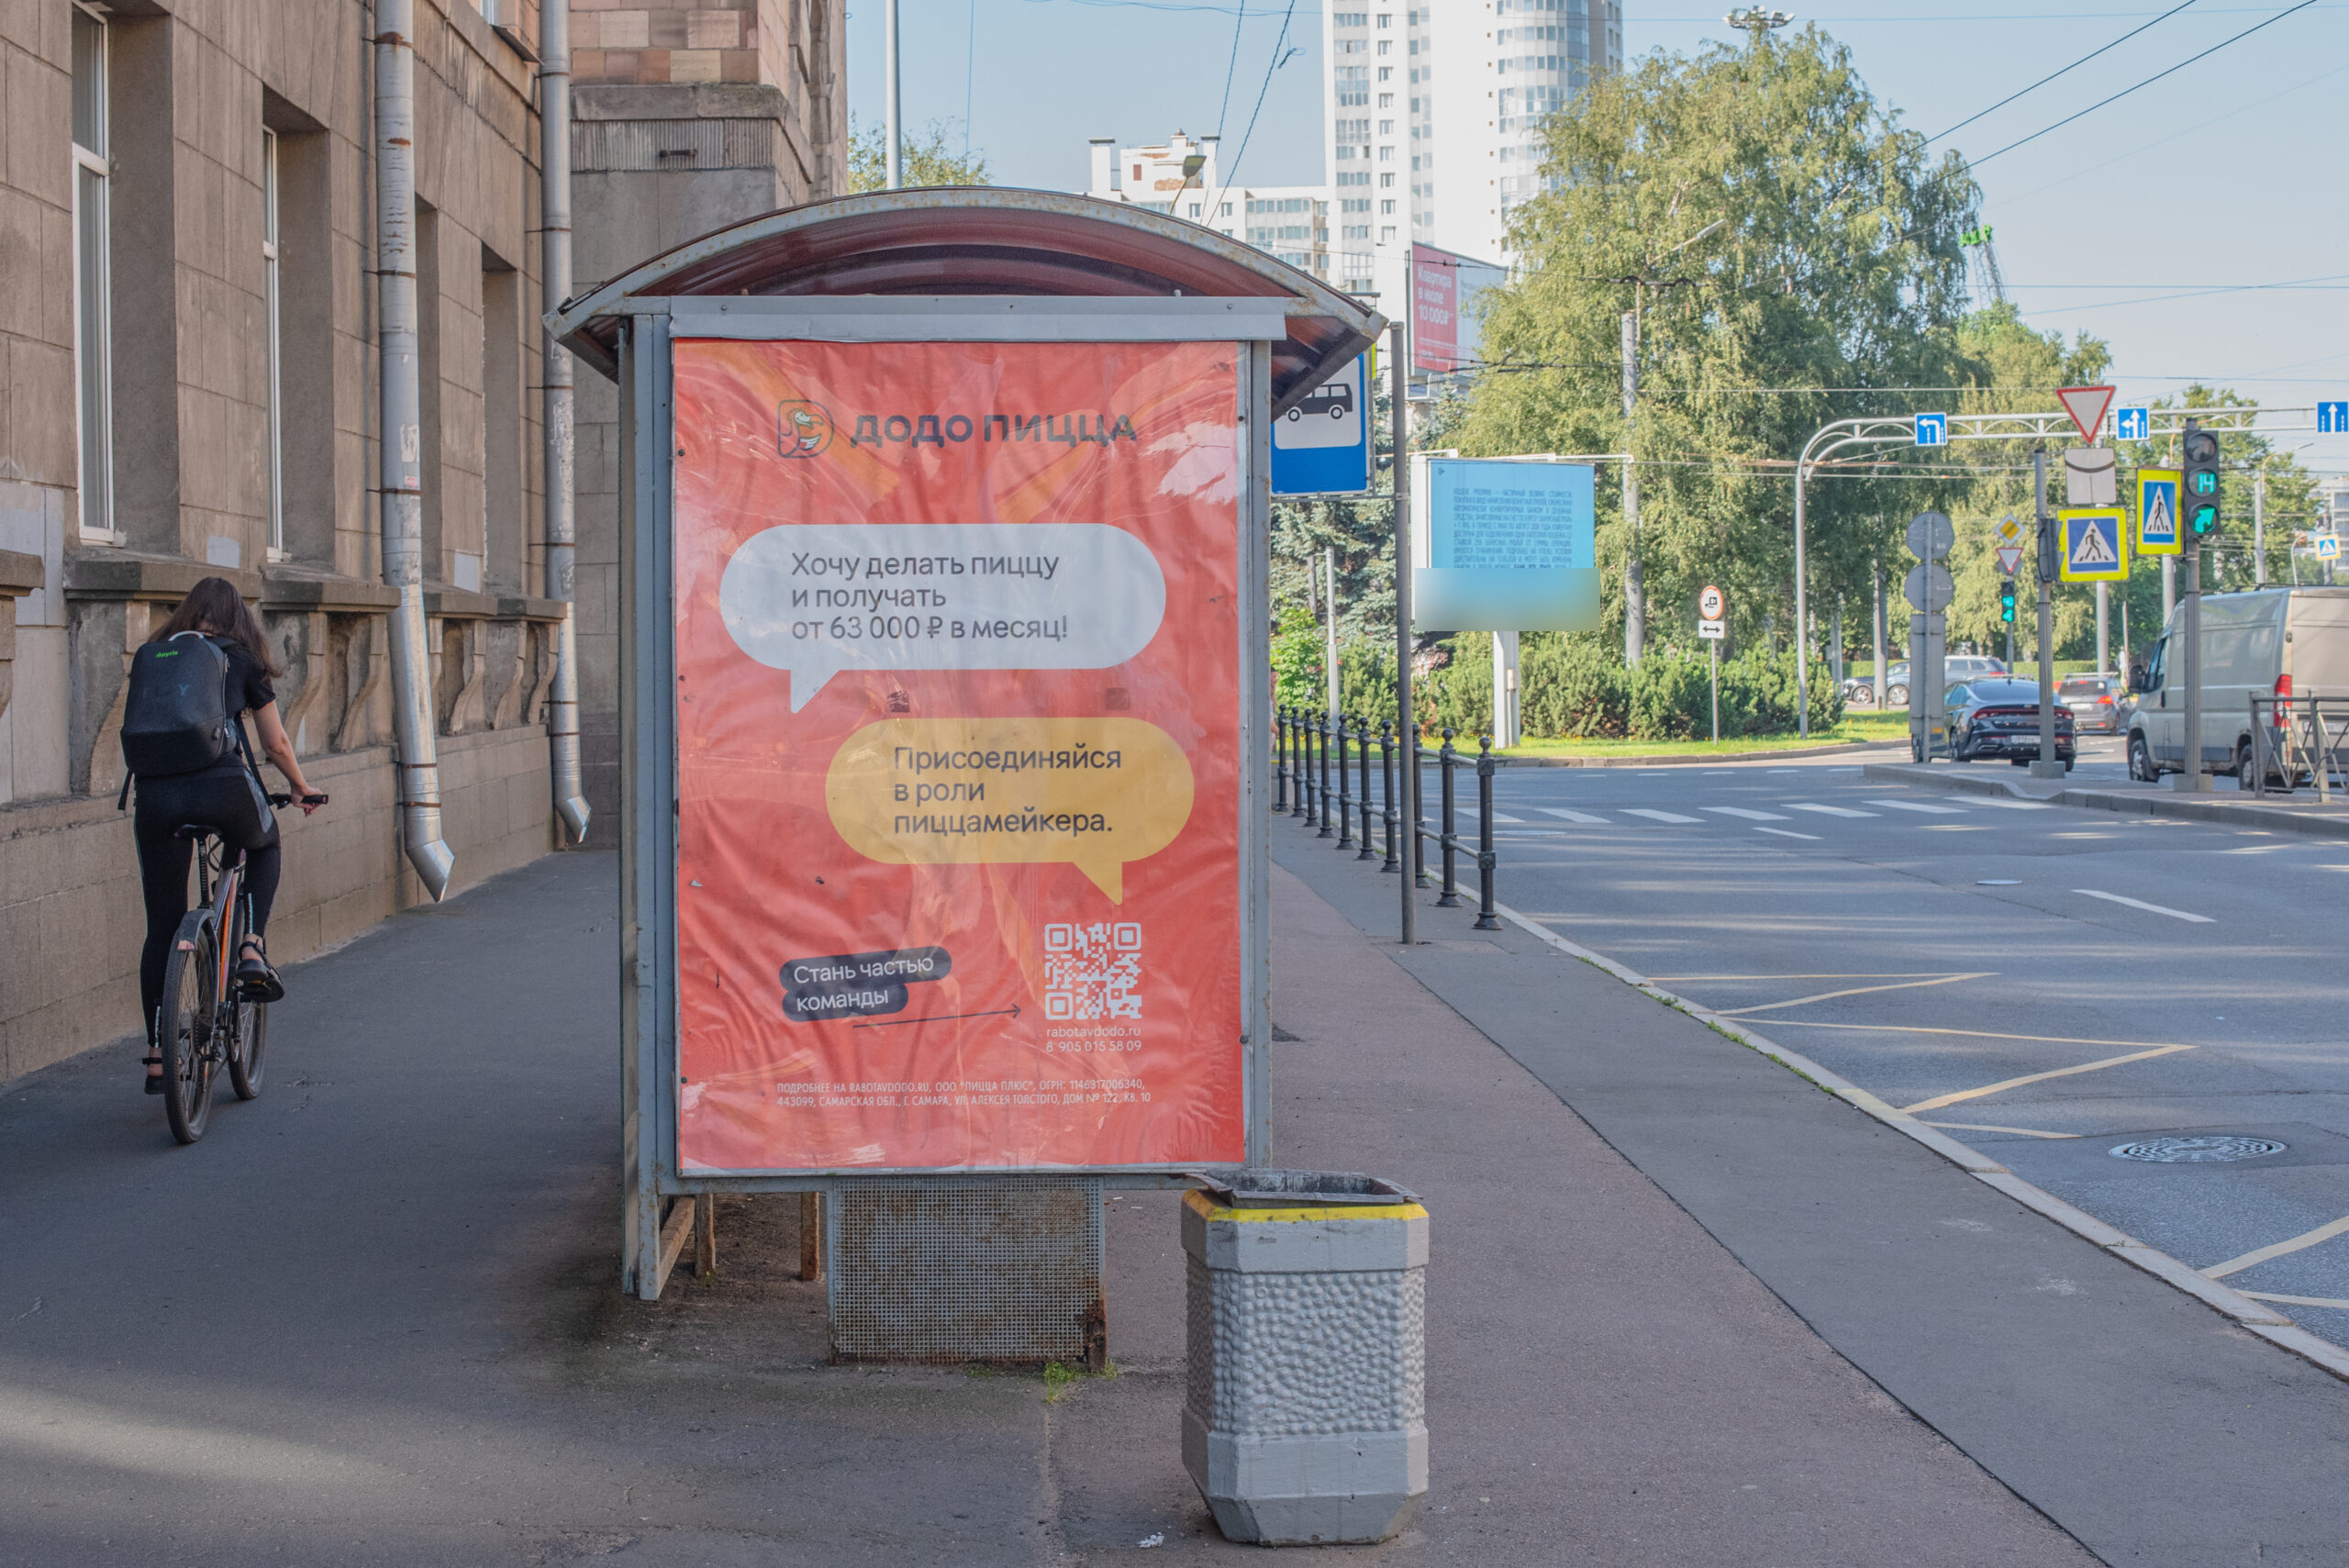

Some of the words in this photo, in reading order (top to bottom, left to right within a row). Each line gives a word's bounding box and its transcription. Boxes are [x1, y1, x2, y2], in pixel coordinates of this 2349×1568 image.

[850, 415, 974, 449] ДОДО
[984, 413, 1137, 449] ПИЦЦА
[2198, 473, 2215, 493] 14
[791, 552, 859, 581] Хочу
[866, 556, 965, 579] делать
[971, 555, 1060, 581] пиццу
[792, 589, 809, 607] и
[817, 588, 947, 612] получать
[791, 622, 824, 639] от
[829, 616, 863, 639] 63
[869, 616, 919, 639] 000
[927, 615, 944, 639] ₽
[952, 620, 965, 639] в
[971, 614, 1069, 642] месяц!
[894, 742, 1122, 774] Присоединяйся
[895, 784, 909, 802] в
[916, 782, 985, 808] роли
[894, 806, 1114, 838] пиццамейкера.
[793, 962, 857, 985] Стань
[860, 954, 935, 978] частью
[796, 988, 890, 1013] команды
[1046, 1025, 1141, 1038] rabotavdodo.ru
[1046, 1041, 1053, 1052] 8
[1059, 1041, 1082, 1052] 905
[1085, 1040, 1107, 1052] 015
[1108, 1040, 1124, 1051] 58
[1126, 1040, 1142, 1051] 09
[777, 1083, 830, 1095] ПОДРОБНЕЕ
[833, 1083, 846, 1093] НА
[935, 1081, 956, 1092] ООО
[1039, 1079, 1066, 1091] ОГРН:
[777, 1096, 817, 1107] 443099,
[818, 1095, 874, 1107] САМАРСКАЯ
[912, 1095, 952, 1106] САМАРА,
[971, 1094, 1010, 1106] АЛЕКСЕЯ
[1013, 1094, 1061, 1106] ТОЛСТОГО,
[1063, 1093, 1084, 1106] ДОМ
[1124, 1092, 1138, 1103] КВ.
[1140, 1092, 1152, 1103] 10
